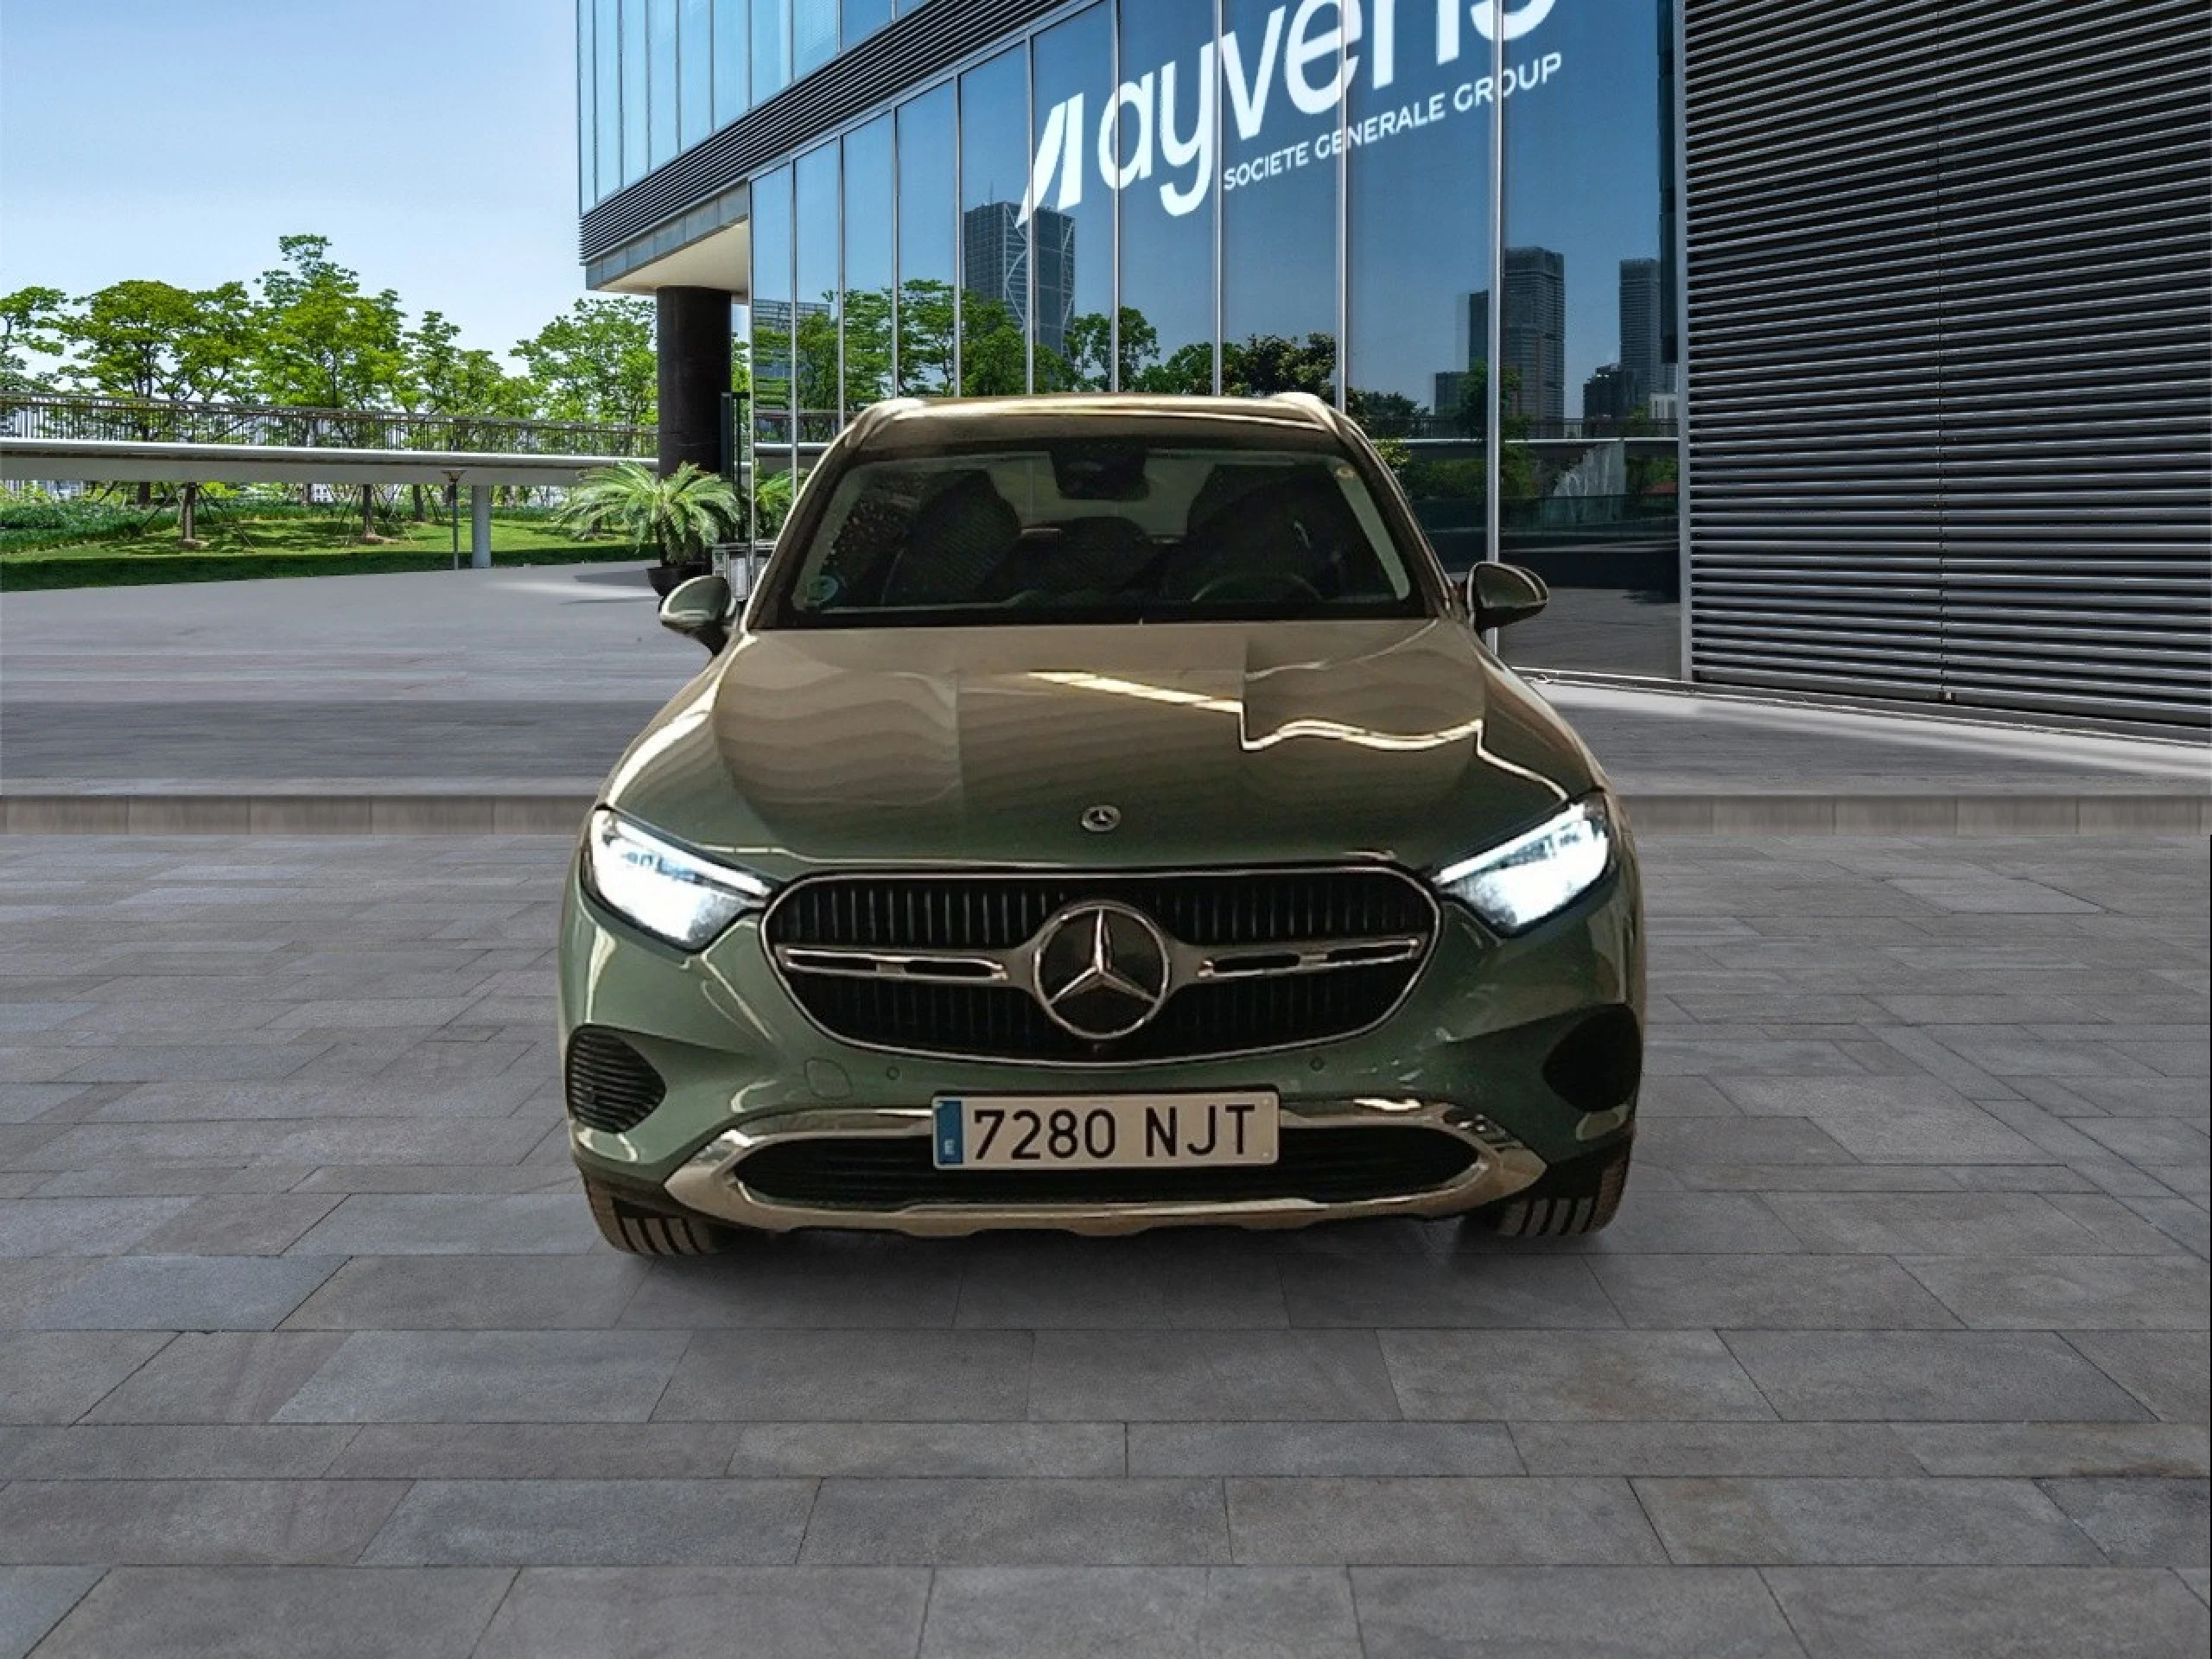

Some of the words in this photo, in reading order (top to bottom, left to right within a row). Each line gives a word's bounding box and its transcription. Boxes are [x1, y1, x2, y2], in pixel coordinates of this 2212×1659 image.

[1224, 141, 1310, 190] SOCIETE
[1314, 92, 1446, 159] GENERALE
[1452, 52, 1562, 112] GROUP
[974, 1109, 1116, 1160] 7280
[1145, 1103, 1255, 1157] NJT
